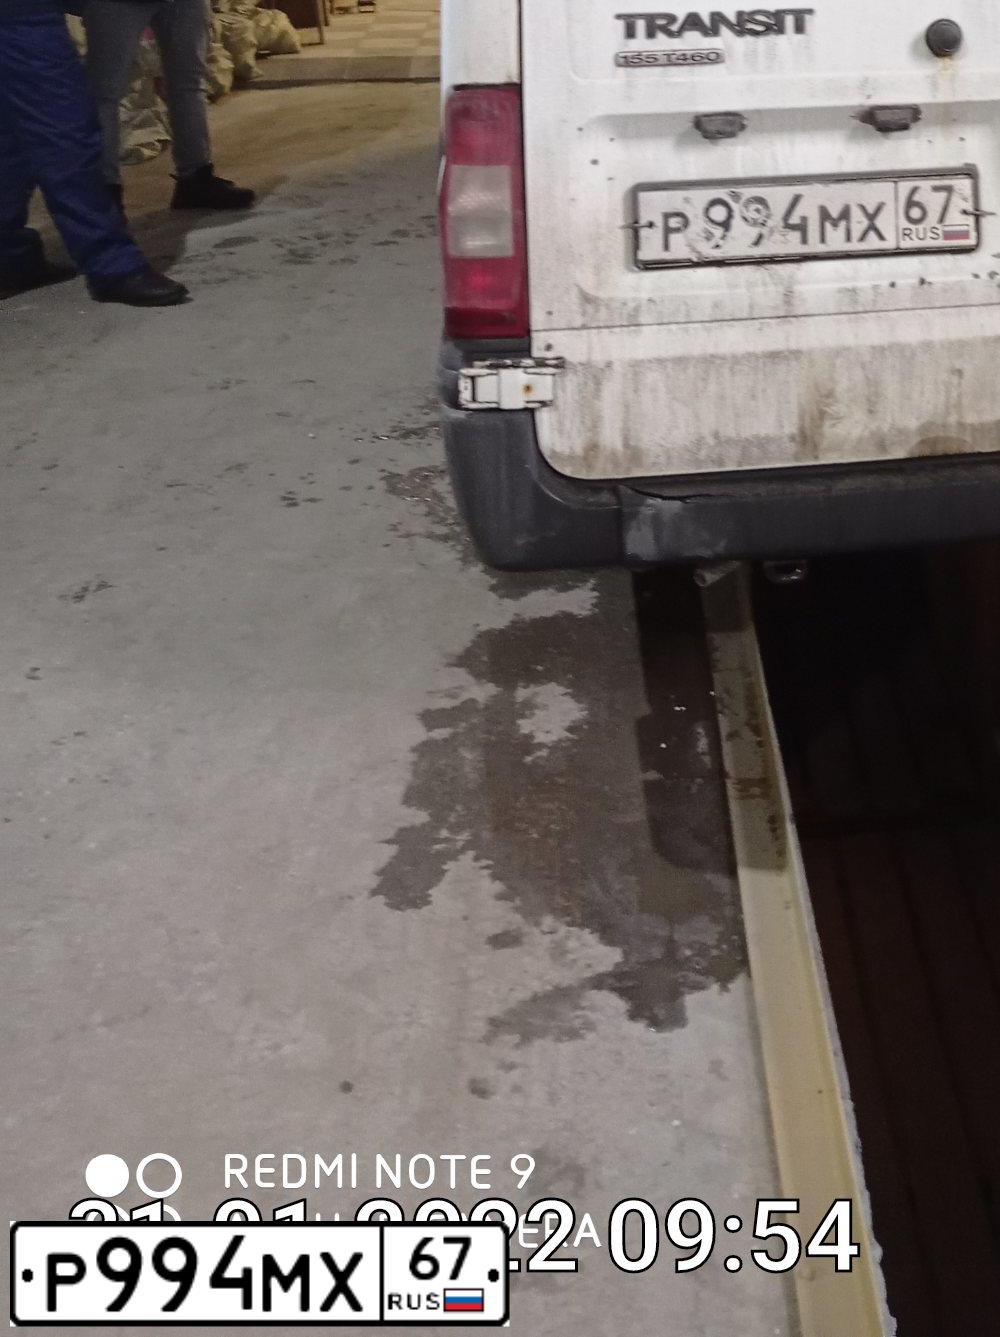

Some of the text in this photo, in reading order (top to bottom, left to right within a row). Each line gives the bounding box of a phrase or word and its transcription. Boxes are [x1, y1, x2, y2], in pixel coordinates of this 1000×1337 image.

[614, 8, 815, 40] TRANSIT
[904, 184, 955, 227] 67
[901, 226, 941, 242] RUS
